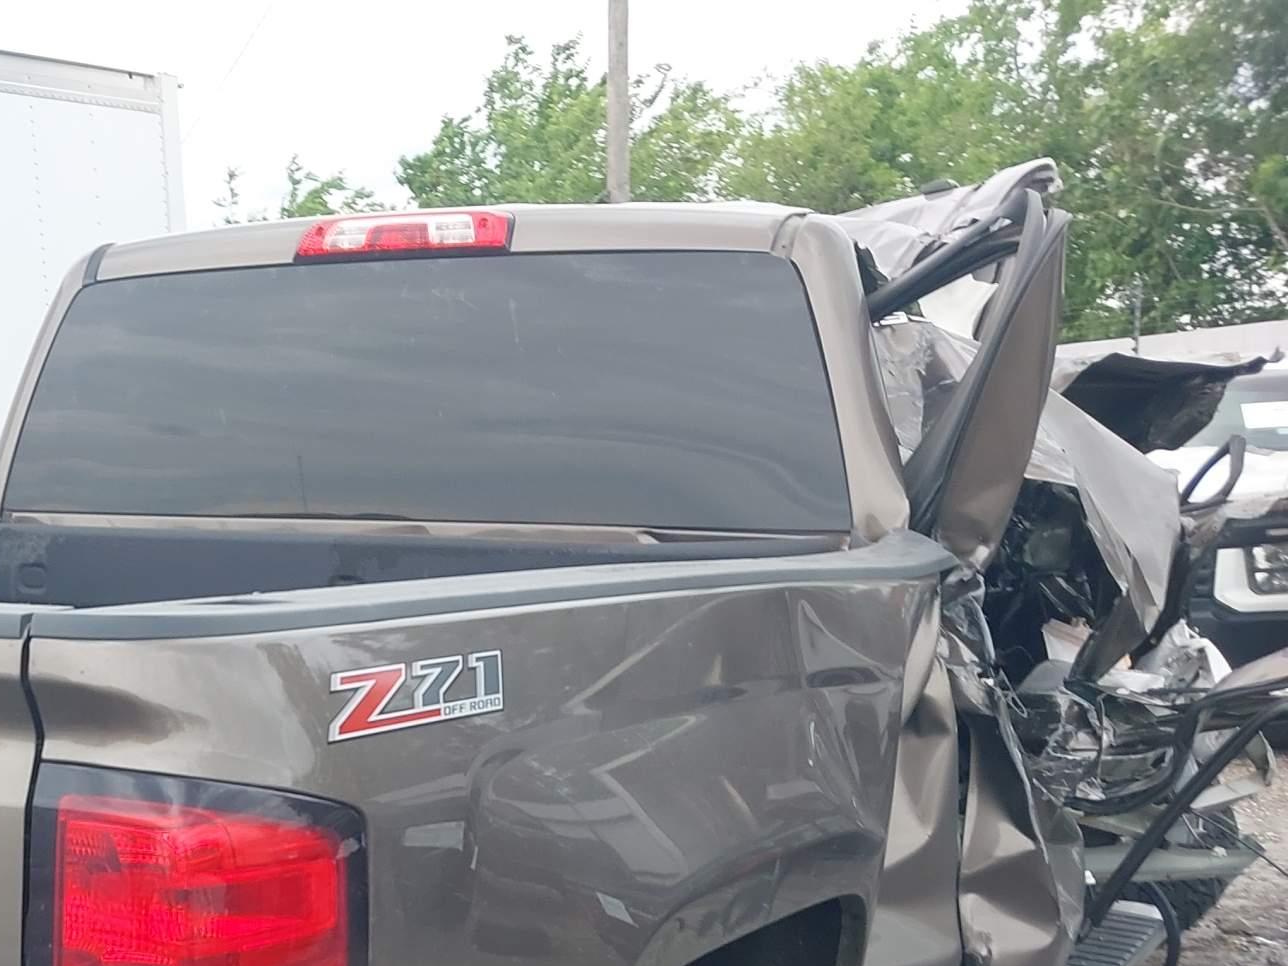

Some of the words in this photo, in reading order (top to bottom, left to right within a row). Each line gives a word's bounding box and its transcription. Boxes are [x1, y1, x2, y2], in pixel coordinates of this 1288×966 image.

[328, 649, 502, 744] Z71
[442, 704, 467, 717] OFF
[469, 697, 502, 712] ROAD
